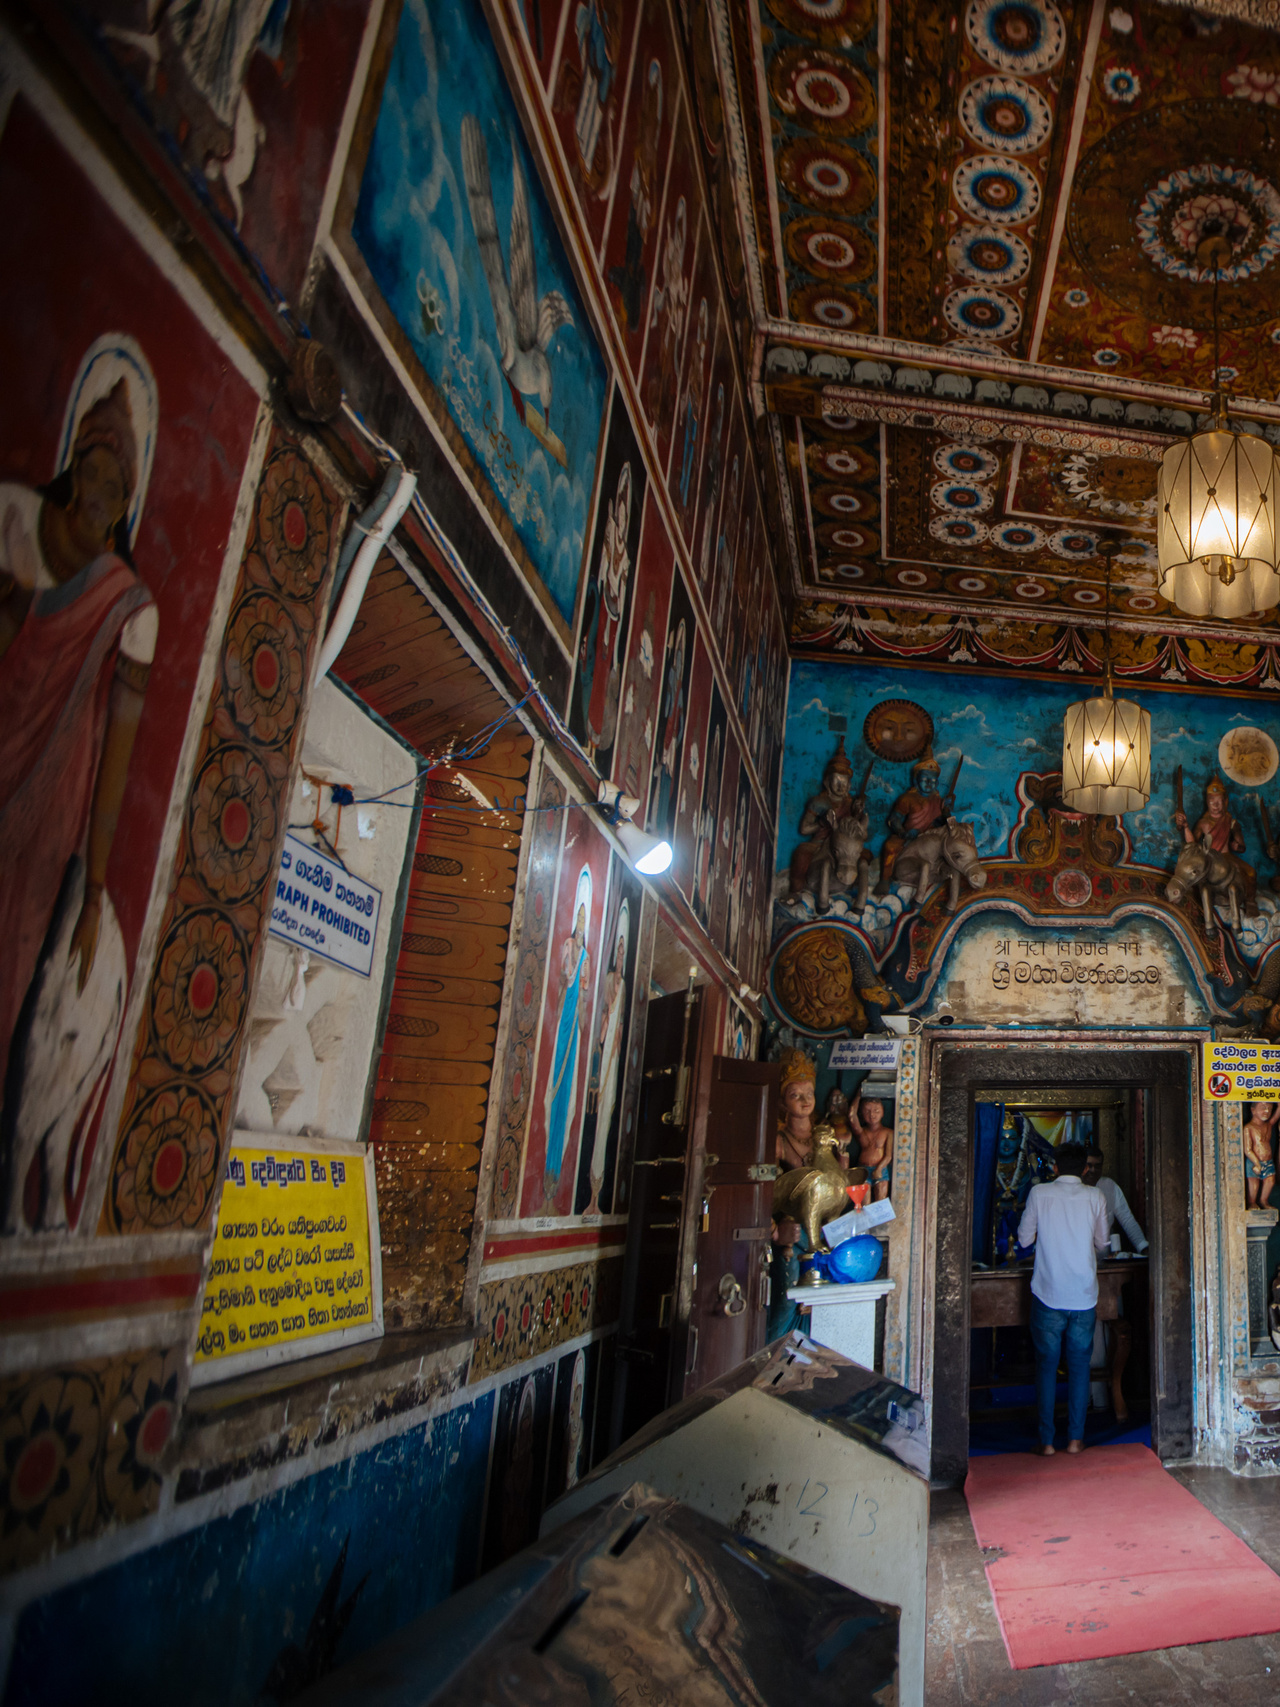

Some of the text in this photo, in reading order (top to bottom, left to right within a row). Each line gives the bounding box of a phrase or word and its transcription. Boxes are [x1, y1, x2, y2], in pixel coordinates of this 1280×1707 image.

[335, 883, 374, 917] තහනම්
[311, 899, 371, 946] PROHIBITED
[1213, 1046, 1257, 1059] දේවාලය
[796, 1478, 829, 1520] 12
[849, 1492, 879, 1537] 13
